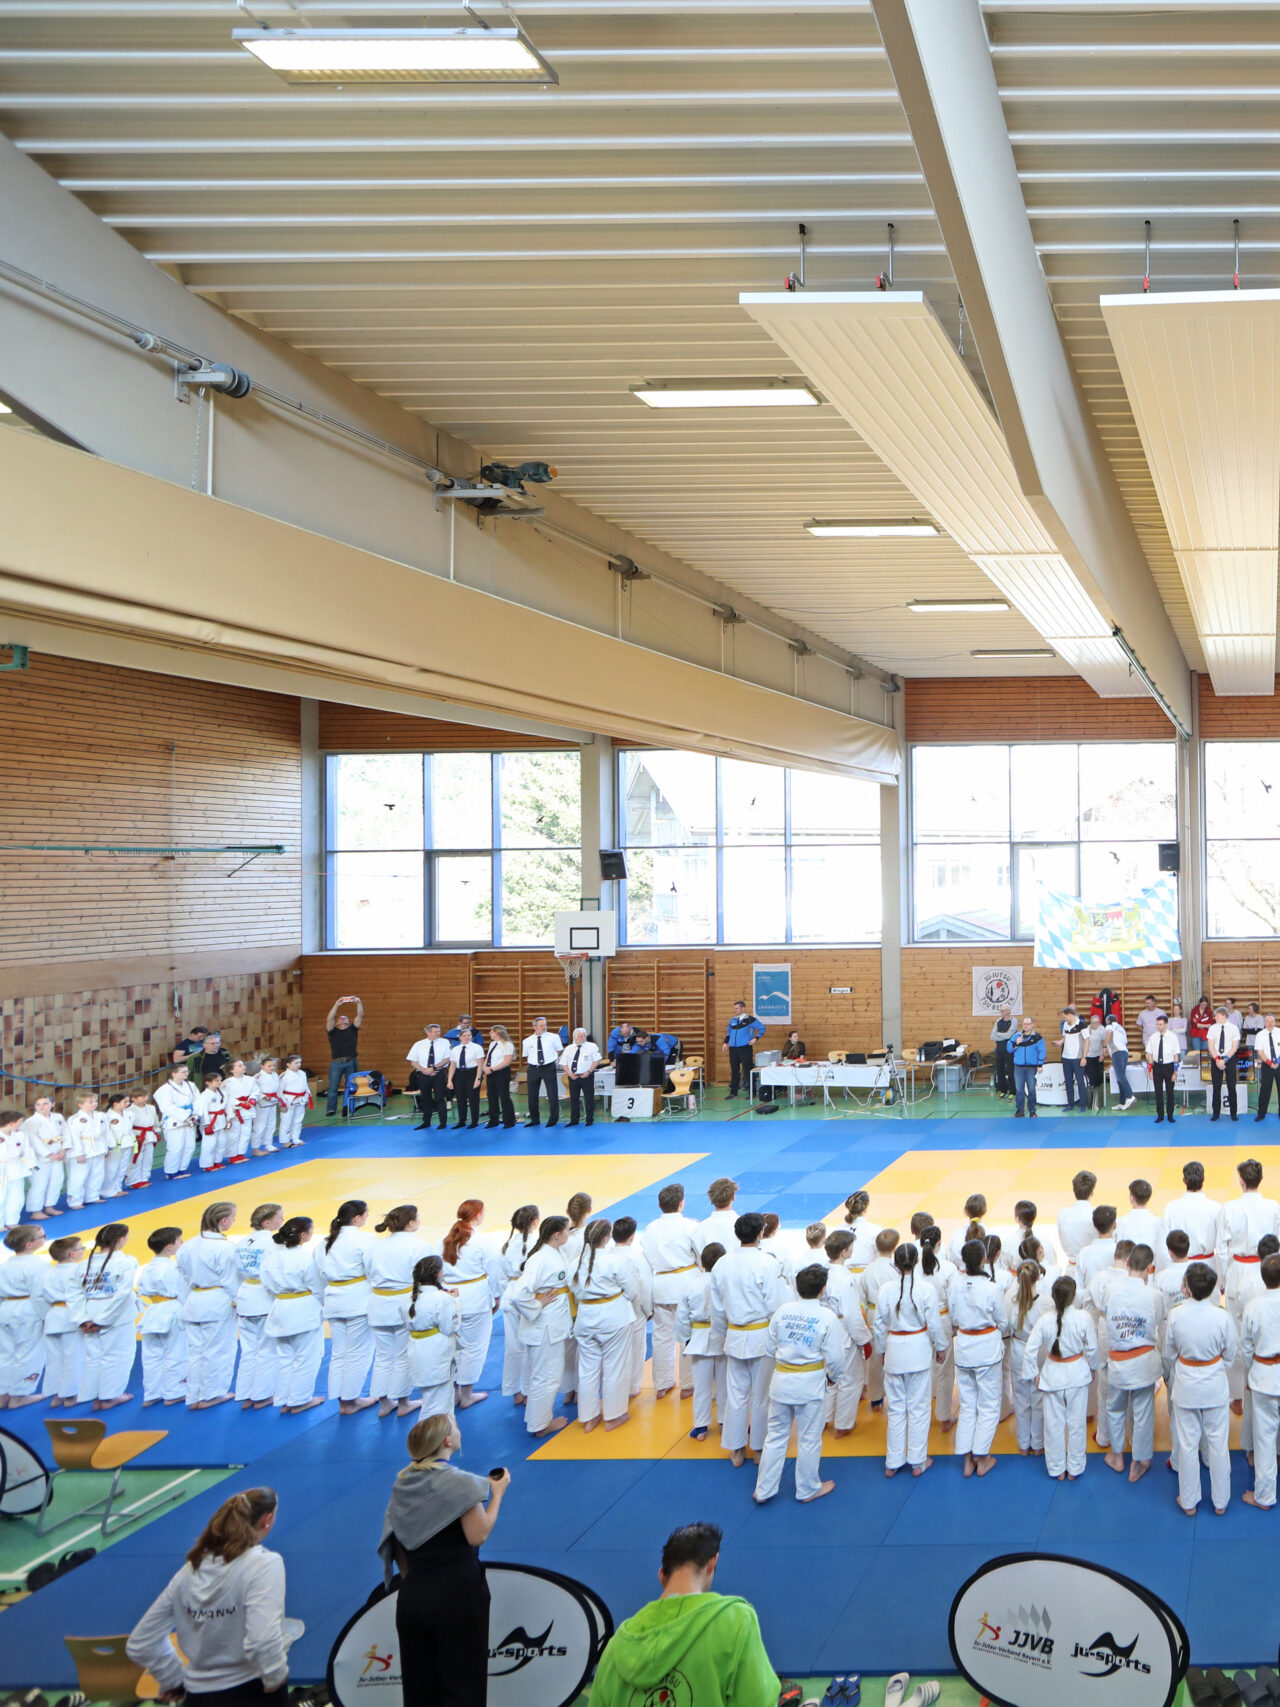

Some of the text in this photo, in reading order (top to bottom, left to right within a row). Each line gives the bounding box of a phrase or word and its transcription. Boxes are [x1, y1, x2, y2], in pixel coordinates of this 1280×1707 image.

[627, 1097, 635, 1110] 3
[1222, 1095, 1230, 1108] 2
[973, 1640, 1021, 1657] Ju-Jutsu-Verband
[1021, 1652, 1041, 1664] Bayern
[1008, 1630, 1055, 1655] JJVB
[487, 1645, 568, 1660] u-sports
[1070, 1642, 1152, 1674] ju-sports
